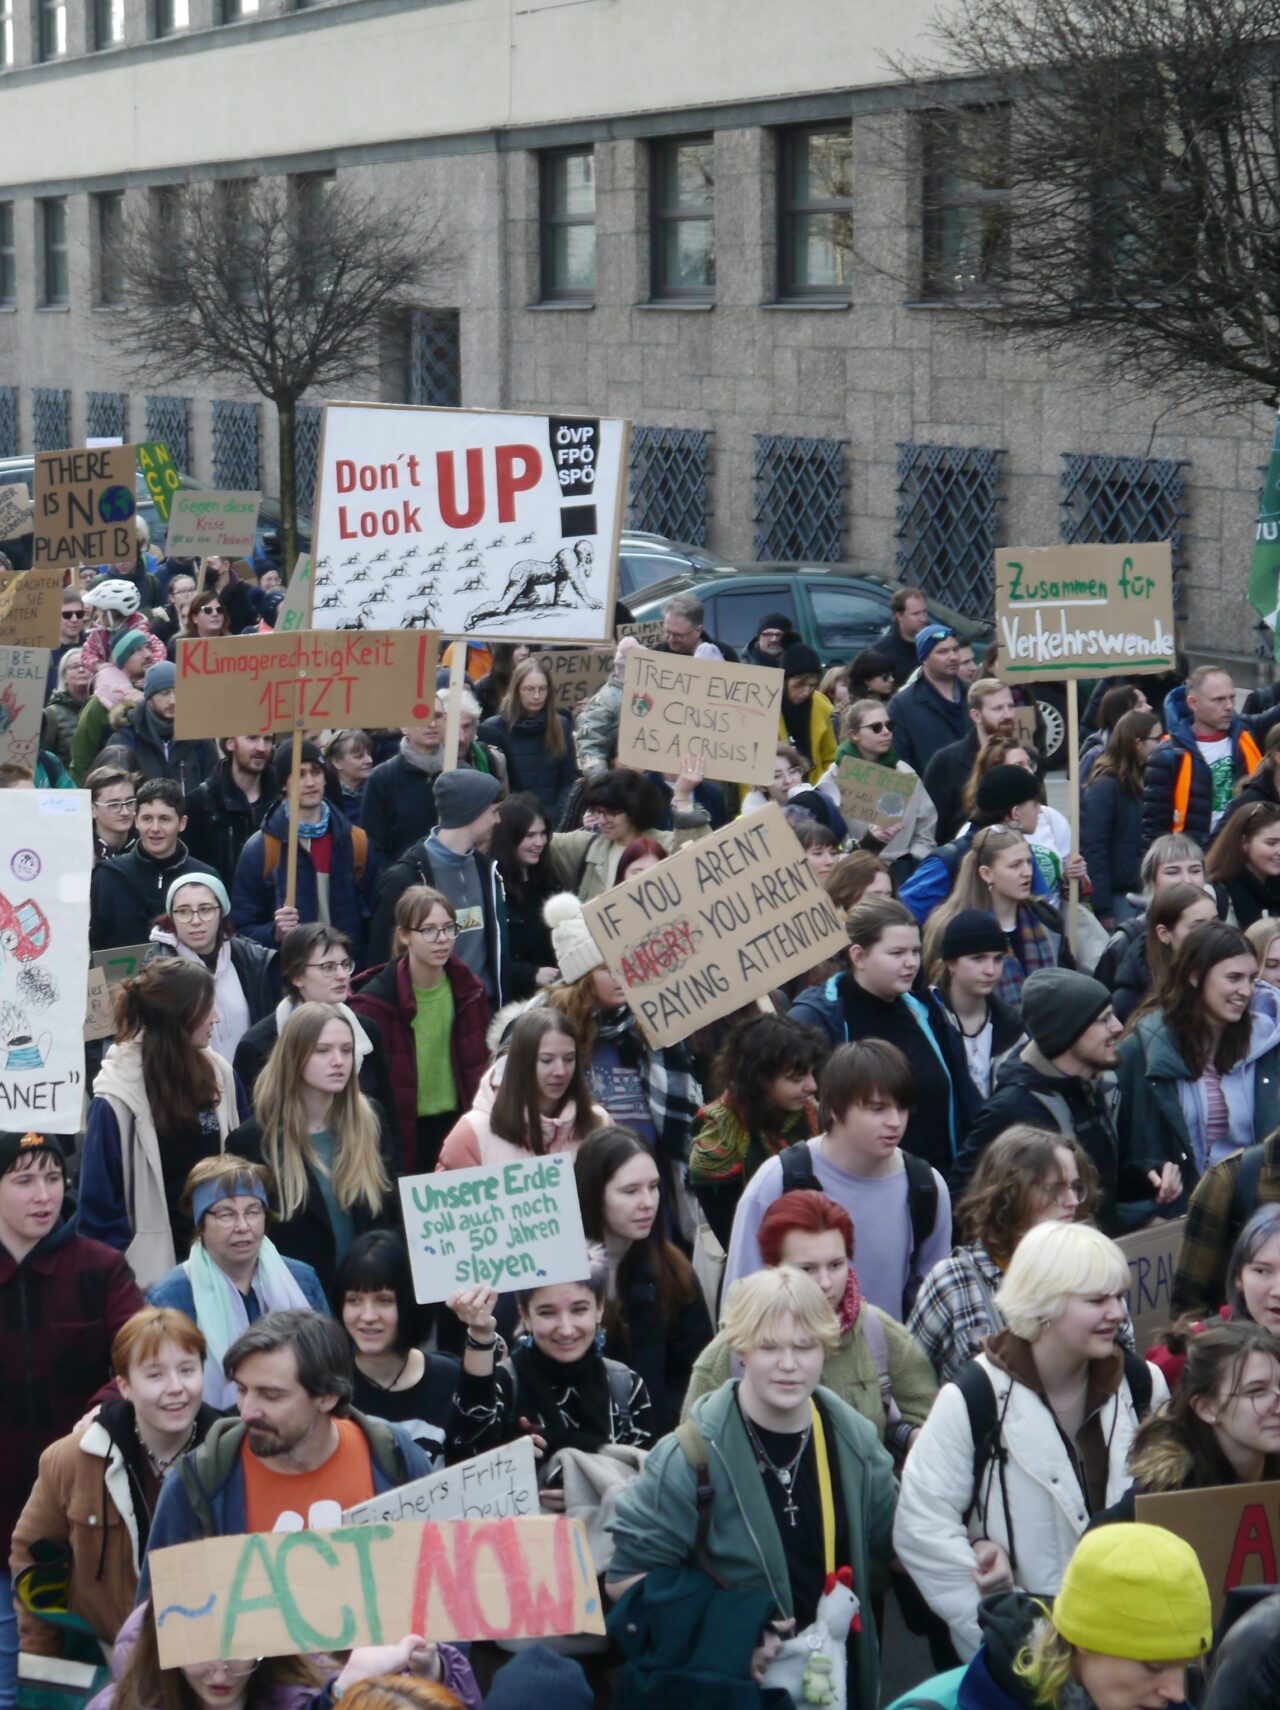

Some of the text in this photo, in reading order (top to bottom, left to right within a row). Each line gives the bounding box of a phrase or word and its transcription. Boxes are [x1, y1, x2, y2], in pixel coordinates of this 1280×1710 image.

[556, 425, 595, 446] ÖVP
[40, 449, 114, 487] THERE
[557, 444, 596, 466] FPÖ
[435, 443, 544, 529] UP
[558, 466, 596, 486] SPÖ
[42, 492, 60, 517] IS
[178, 497, 257, 517] Gegen diese
[338, 499, 424, 540] Look
[196, 516, 226, 532] Krise
[35, 527, 131, 562] PLANET B
[1006, 556, 1155, 601] Zusammen für
[27, 592, 46, 606] SIE
[621, 621, 665, 637] CLIMAT
[1001, 608, 1176, 664] Verkehrswende
[6, 665, 44, 680] REAL
[12, 650, 35, 666] BE
[541, 654, 592, 675] OPEN
[633, 656, 701, 697] TREAT
[708, 675, 781, 708] EVERY
[258, 675, 360, 733] JETZT
[663, 701, 731, 734] CRISIS
[632, 726, 759, 769] AS A CRISIS!
[840, 762, 876, 785] SAVE
[877, 768, 918, 797] TREES
[596, 822, 773, 941] IF YOU AREN'T
[620, 857, 820, 989] ANGRY YOU AREN'T
[641, 900, 842, 1033] PAYING ATTENTION
[411, 1162, 561, 1213] Unsere Erde
[420, 1192, 559, 1240] soll auch noch
[440, 1218, 561, 1256] in 50 Jahren
[460, 1454, 517, 1492] Fritz
[460, 1476, 531, 1522] heute
[220, 1513, 598, 1660] ACT NOW!
